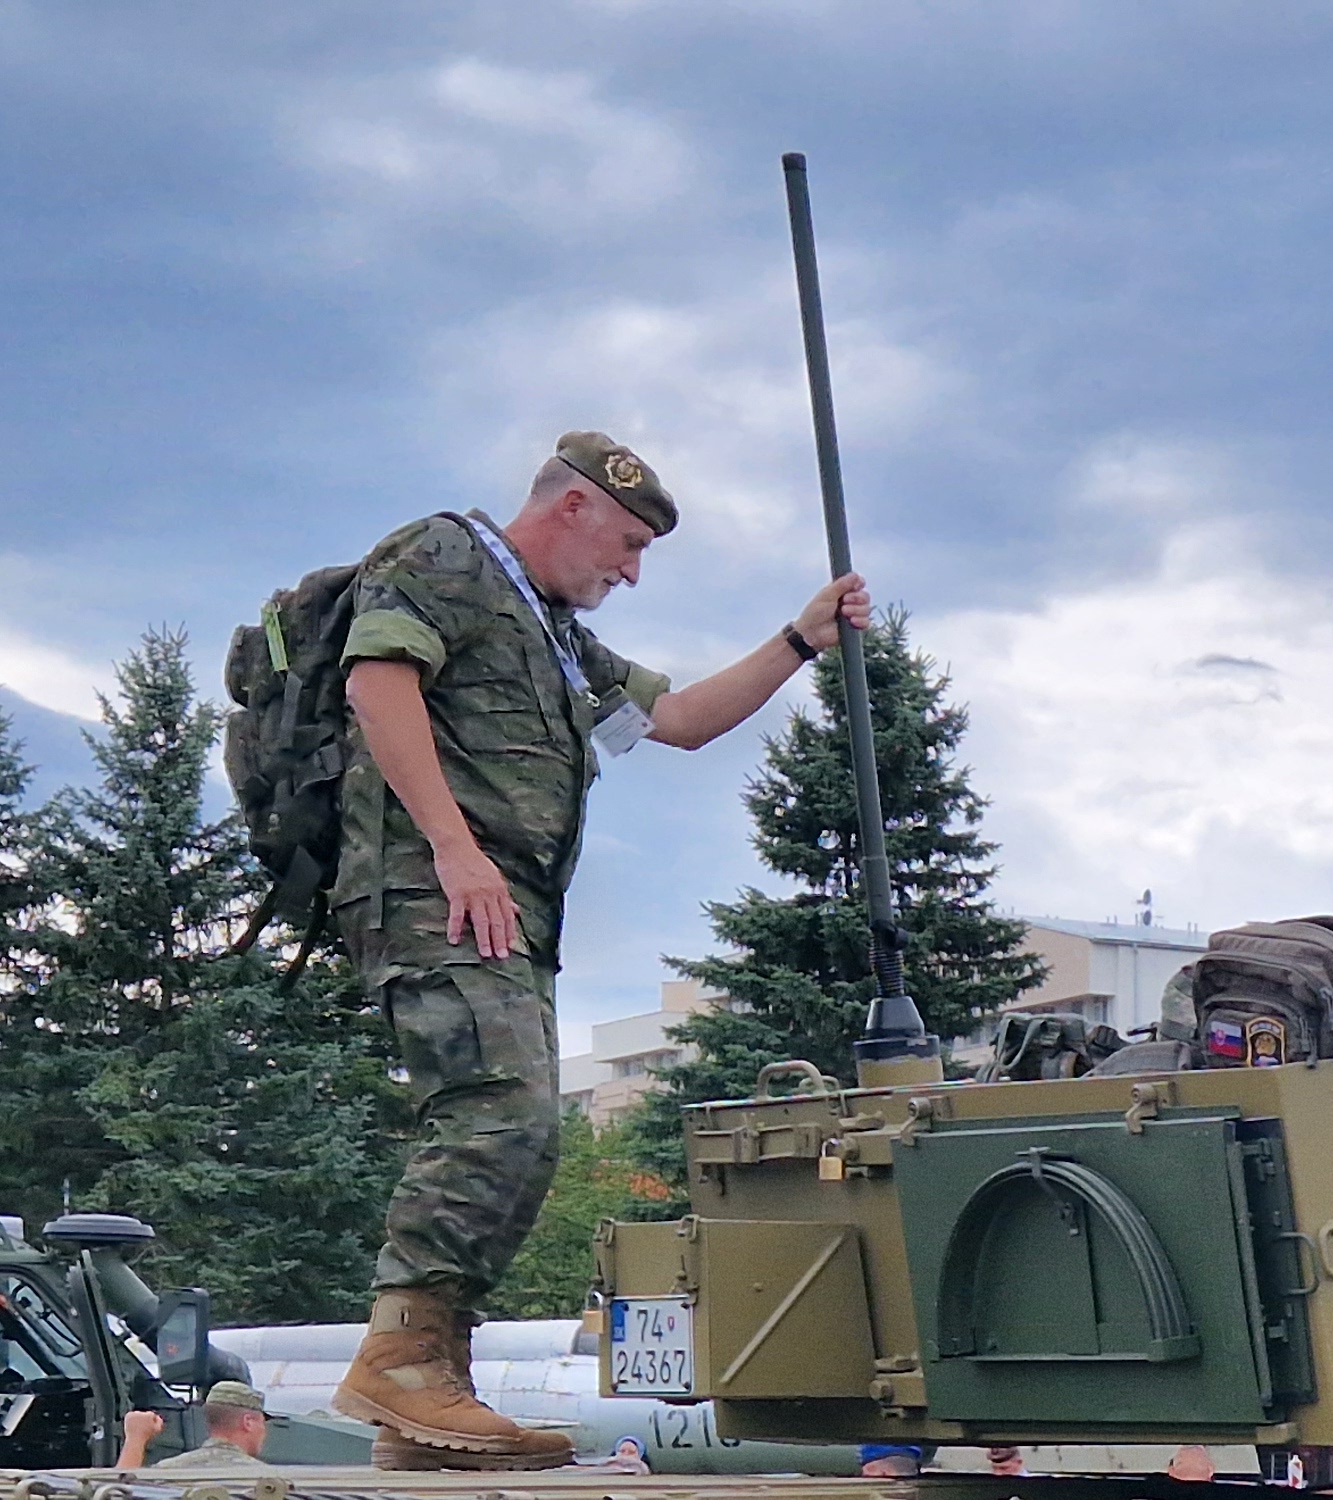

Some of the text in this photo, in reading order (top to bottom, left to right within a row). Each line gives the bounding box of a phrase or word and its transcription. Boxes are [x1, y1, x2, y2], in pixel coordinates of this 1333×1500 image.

[636, 1308, 664, 1343] 74
[616, 1350, 686, 1385] 24367
[648, 1409, 741, 1449] 121
